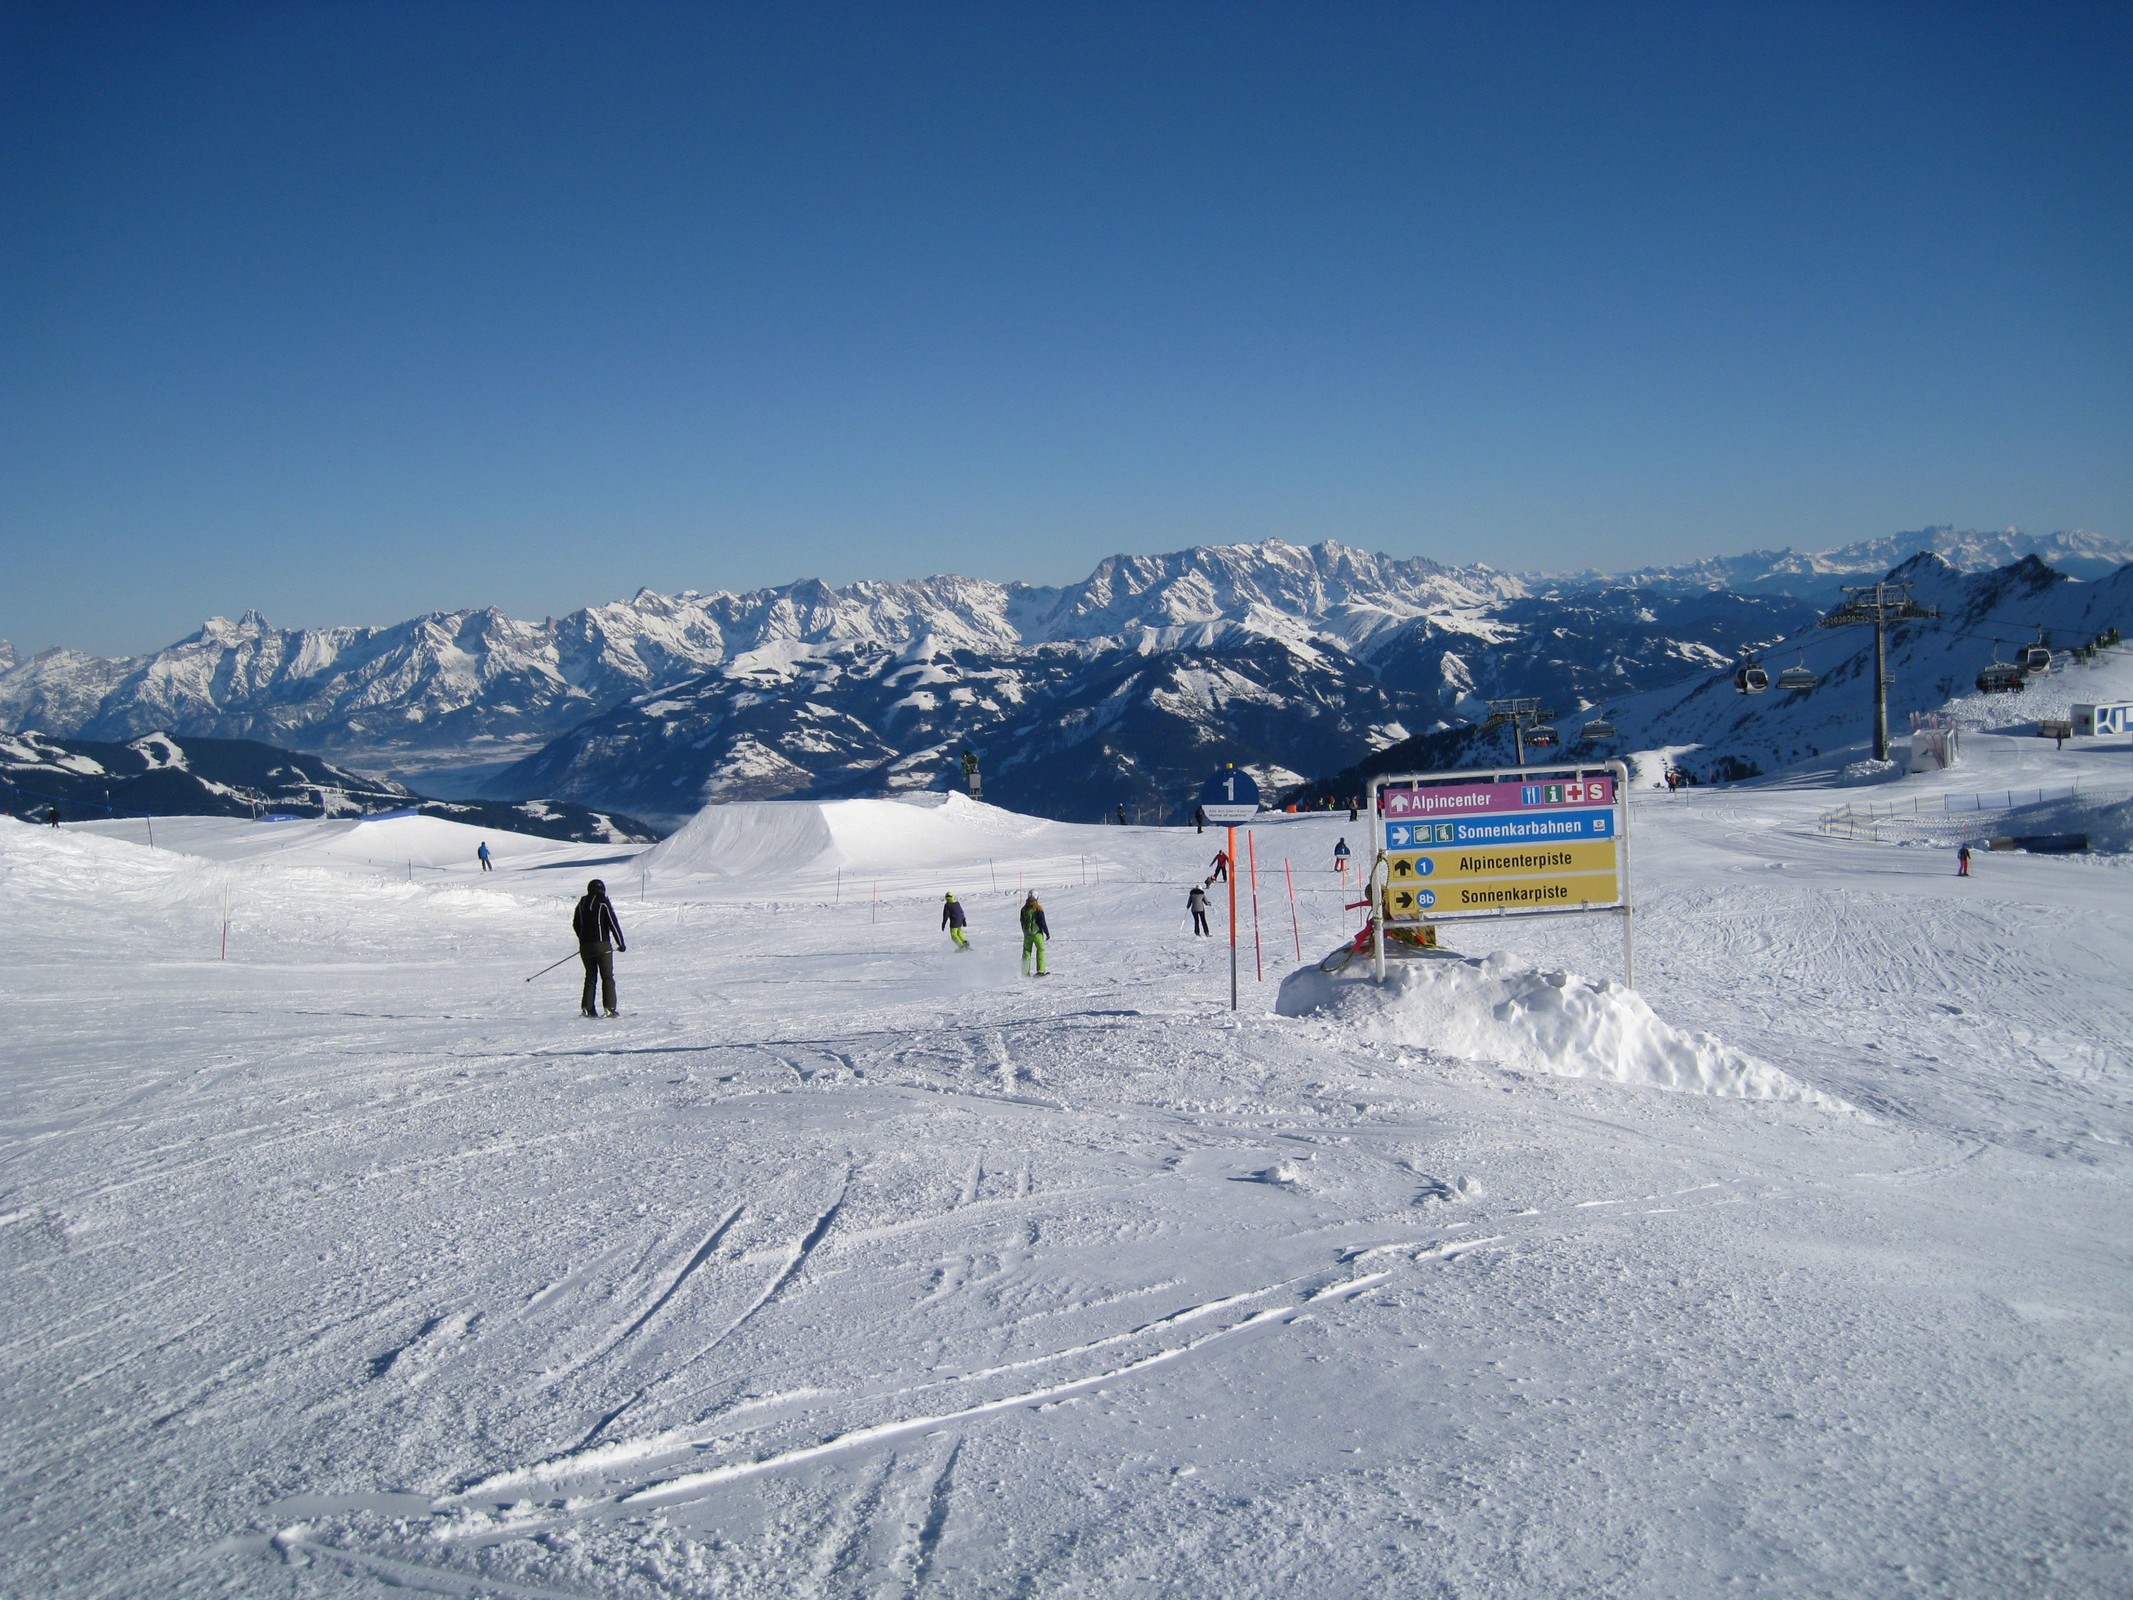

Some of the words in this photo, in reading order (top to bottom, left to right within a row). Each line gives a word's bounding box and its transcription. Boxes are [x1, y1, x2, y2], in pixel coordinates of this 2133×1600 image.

[1222, 777, 1234, 801] 1
[1412, 792, 1491, 811] Alpincenter
[1458, 820, 1581, 839] Sonnenkarbahnen
[1420, 862, 1426, 873] 1
[1460, 852, 1572, 873] Alpincenterpiste
[1419, 894, 1434, 904] 8b
[1461, 885, 1568, 903] Sonnenkarpiste
